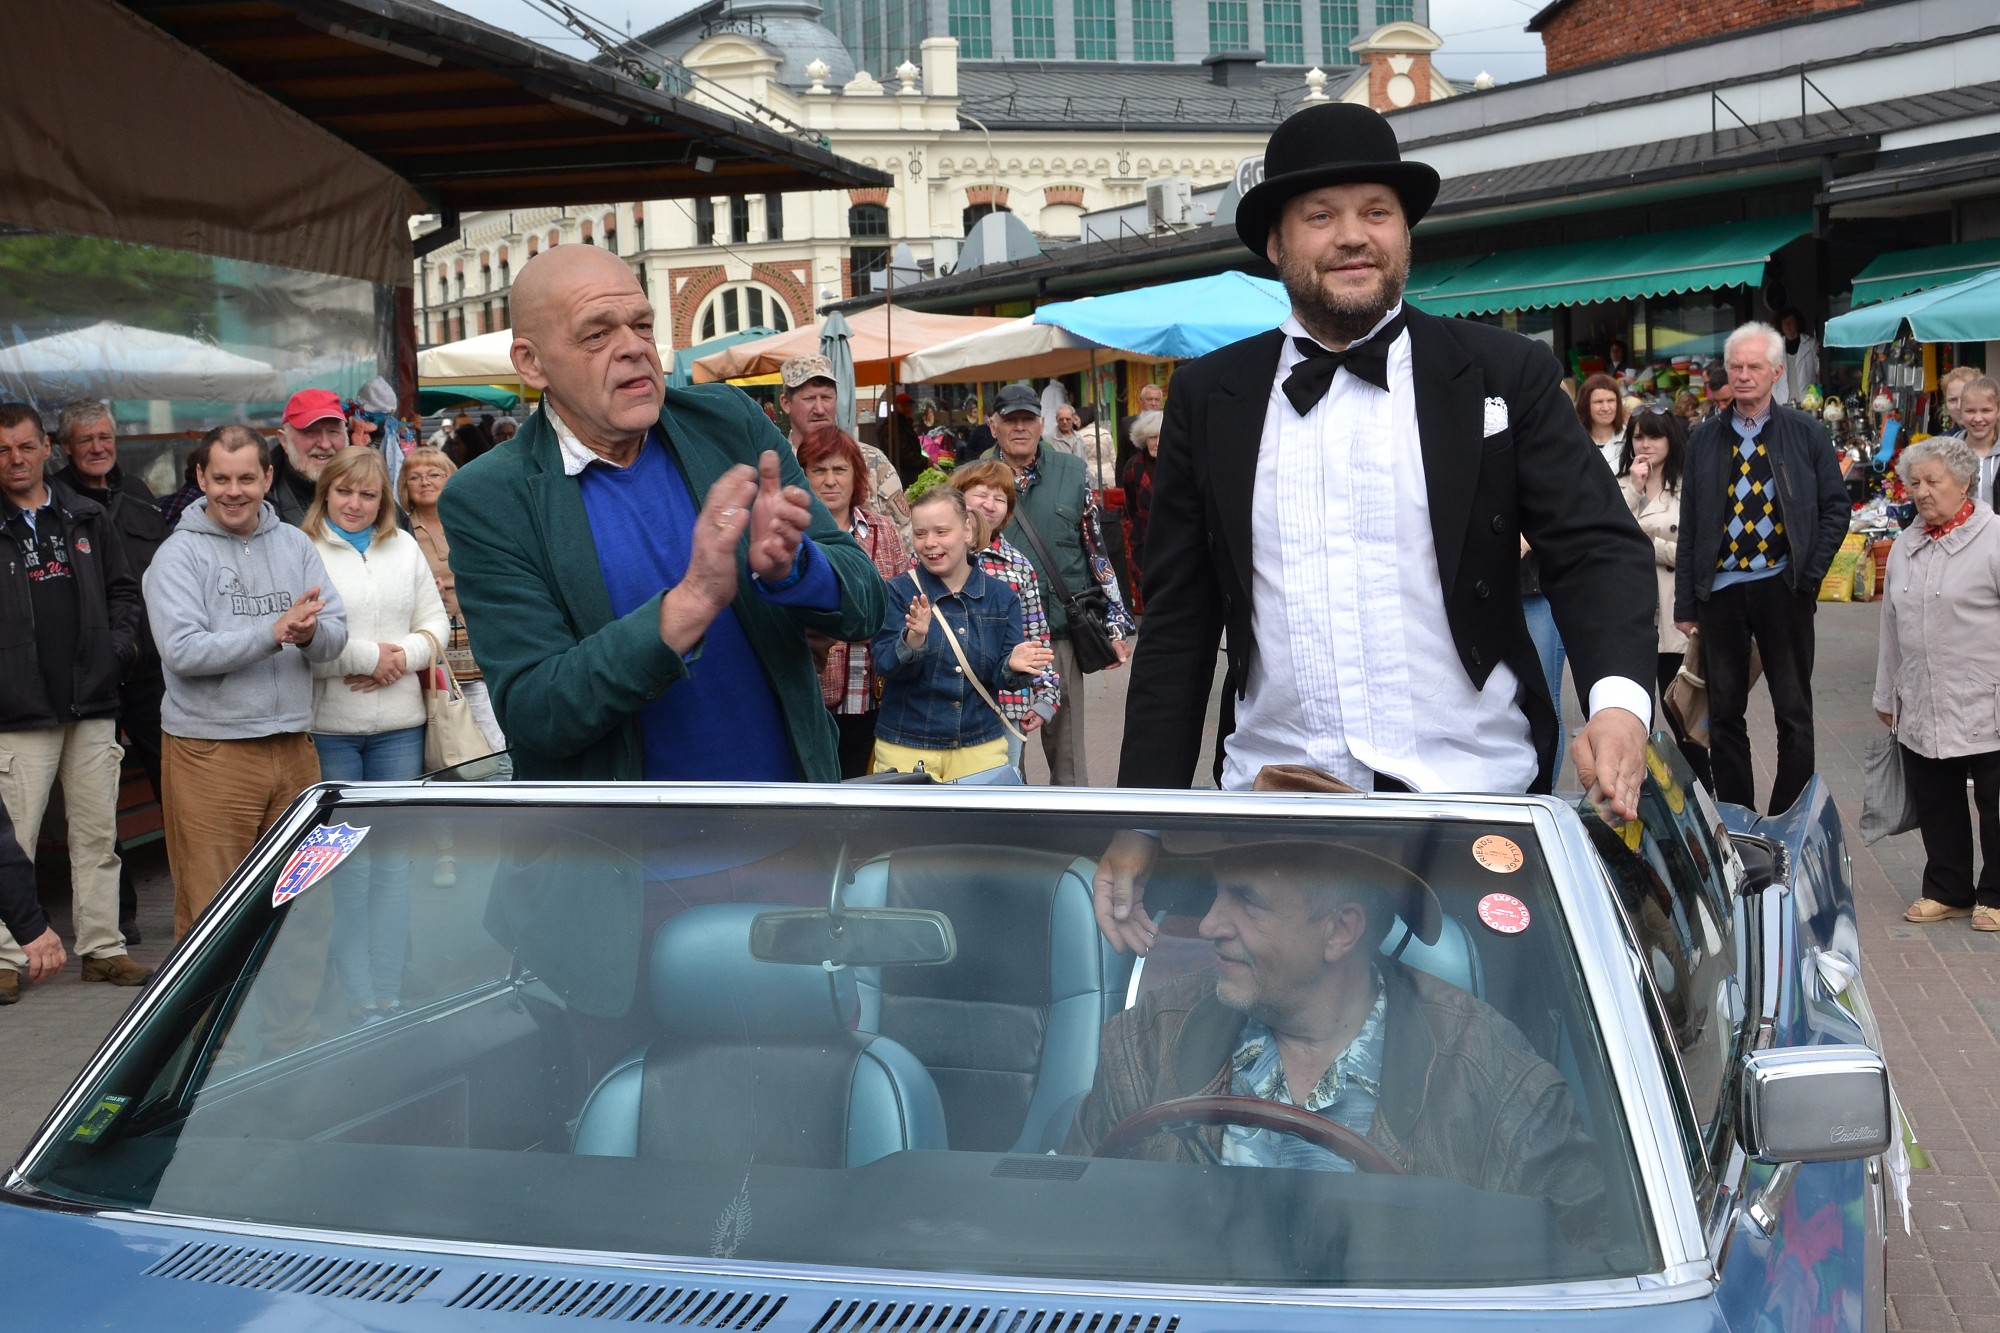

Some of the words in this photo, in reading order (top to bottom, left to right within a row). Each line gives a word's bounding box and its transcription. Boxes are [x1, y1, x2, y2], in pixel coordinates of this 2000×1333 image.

[231, 591, 293, 617] BROWNS
[1475, 838, 1493, 867] FRIENDS
[1504, 841, 1520, 871] VILLAGE
[278, 861, 321, 894] 51
[1480, 900, 1493, 922] ZONE
[1492, 895, 1519, 906] EXPO
[1517, 905, 1530, 928] ZONE
[1829, 1125, 1879, 1144] Cadillac
